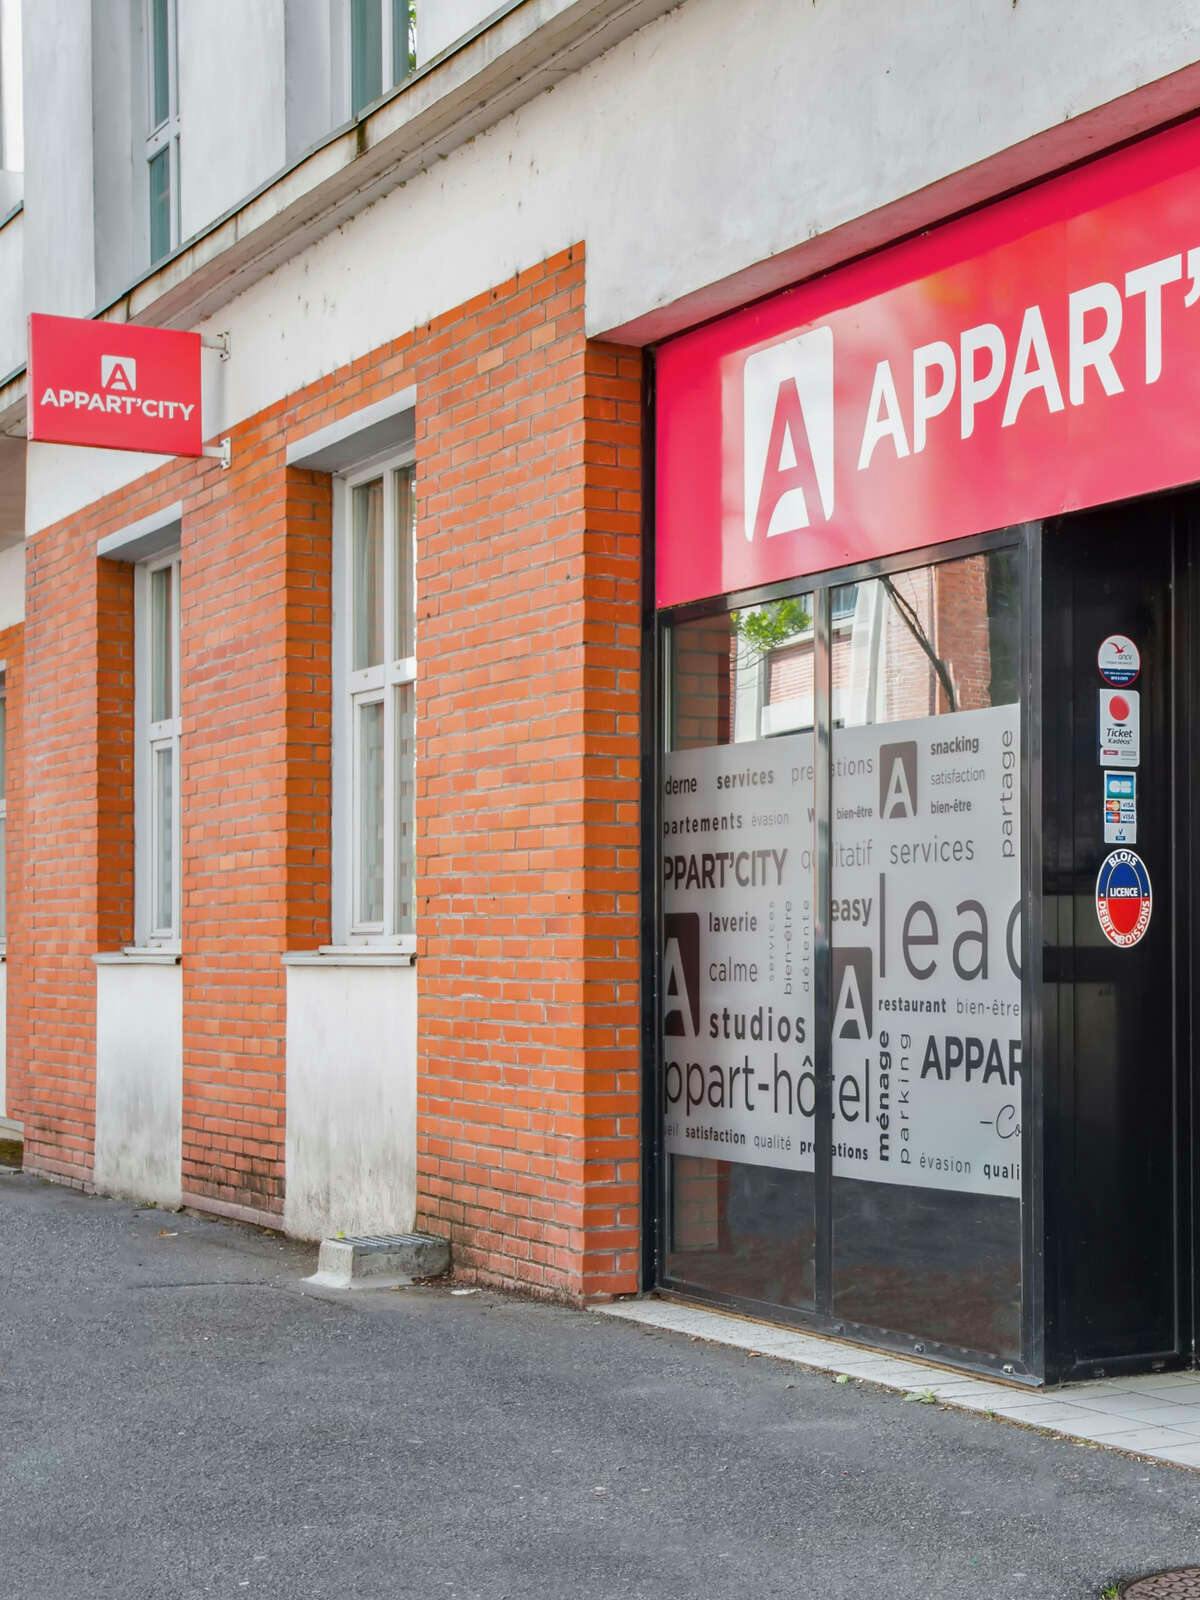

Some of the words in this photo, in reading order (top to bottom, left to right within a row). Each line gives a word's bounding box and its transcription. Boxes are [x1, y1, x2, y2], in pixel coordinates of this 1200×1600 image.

[39, 387, 196, 421] APPART'CITY
[930, 736, 979, 756] snacking
[1106, 727, 1133, 738] Ticket
[665, 775, 697, 795] derne
[716, 768, 775, 790] services
[930, 766, 986, 786] satisfaction
[930, 799, 972, 815] bien-être
[1000, 729, 1015, 858] partage
[664, 811, 743, 839] partements
[836, 804, 873, 820] bien-être
[889, 834, 975, 865] services
[1108, 851, 1138, 867] BLOIS
[1109, 887, 1138, 897] LICENCE
[709, 911, 758, 933] laverie
[831, 897, 873, 927] easy
[709, 956, 758, 983] calme
[878, 997, 947, 1014] restaurant
[956, 998, 1020, 1017] bien-être
[709, 1005, 806, 1044] studios
[664, 1052, 870, 1123] ppart-hôel
[876, 1030, 891, 1162] ménage
[898, 1033, 911, 1164] parking
[685, 1125, 746, 1145] satisfaction
[754, 1133, 791, 1151] qualité
[919, 1151, 971, 1175] évasion
